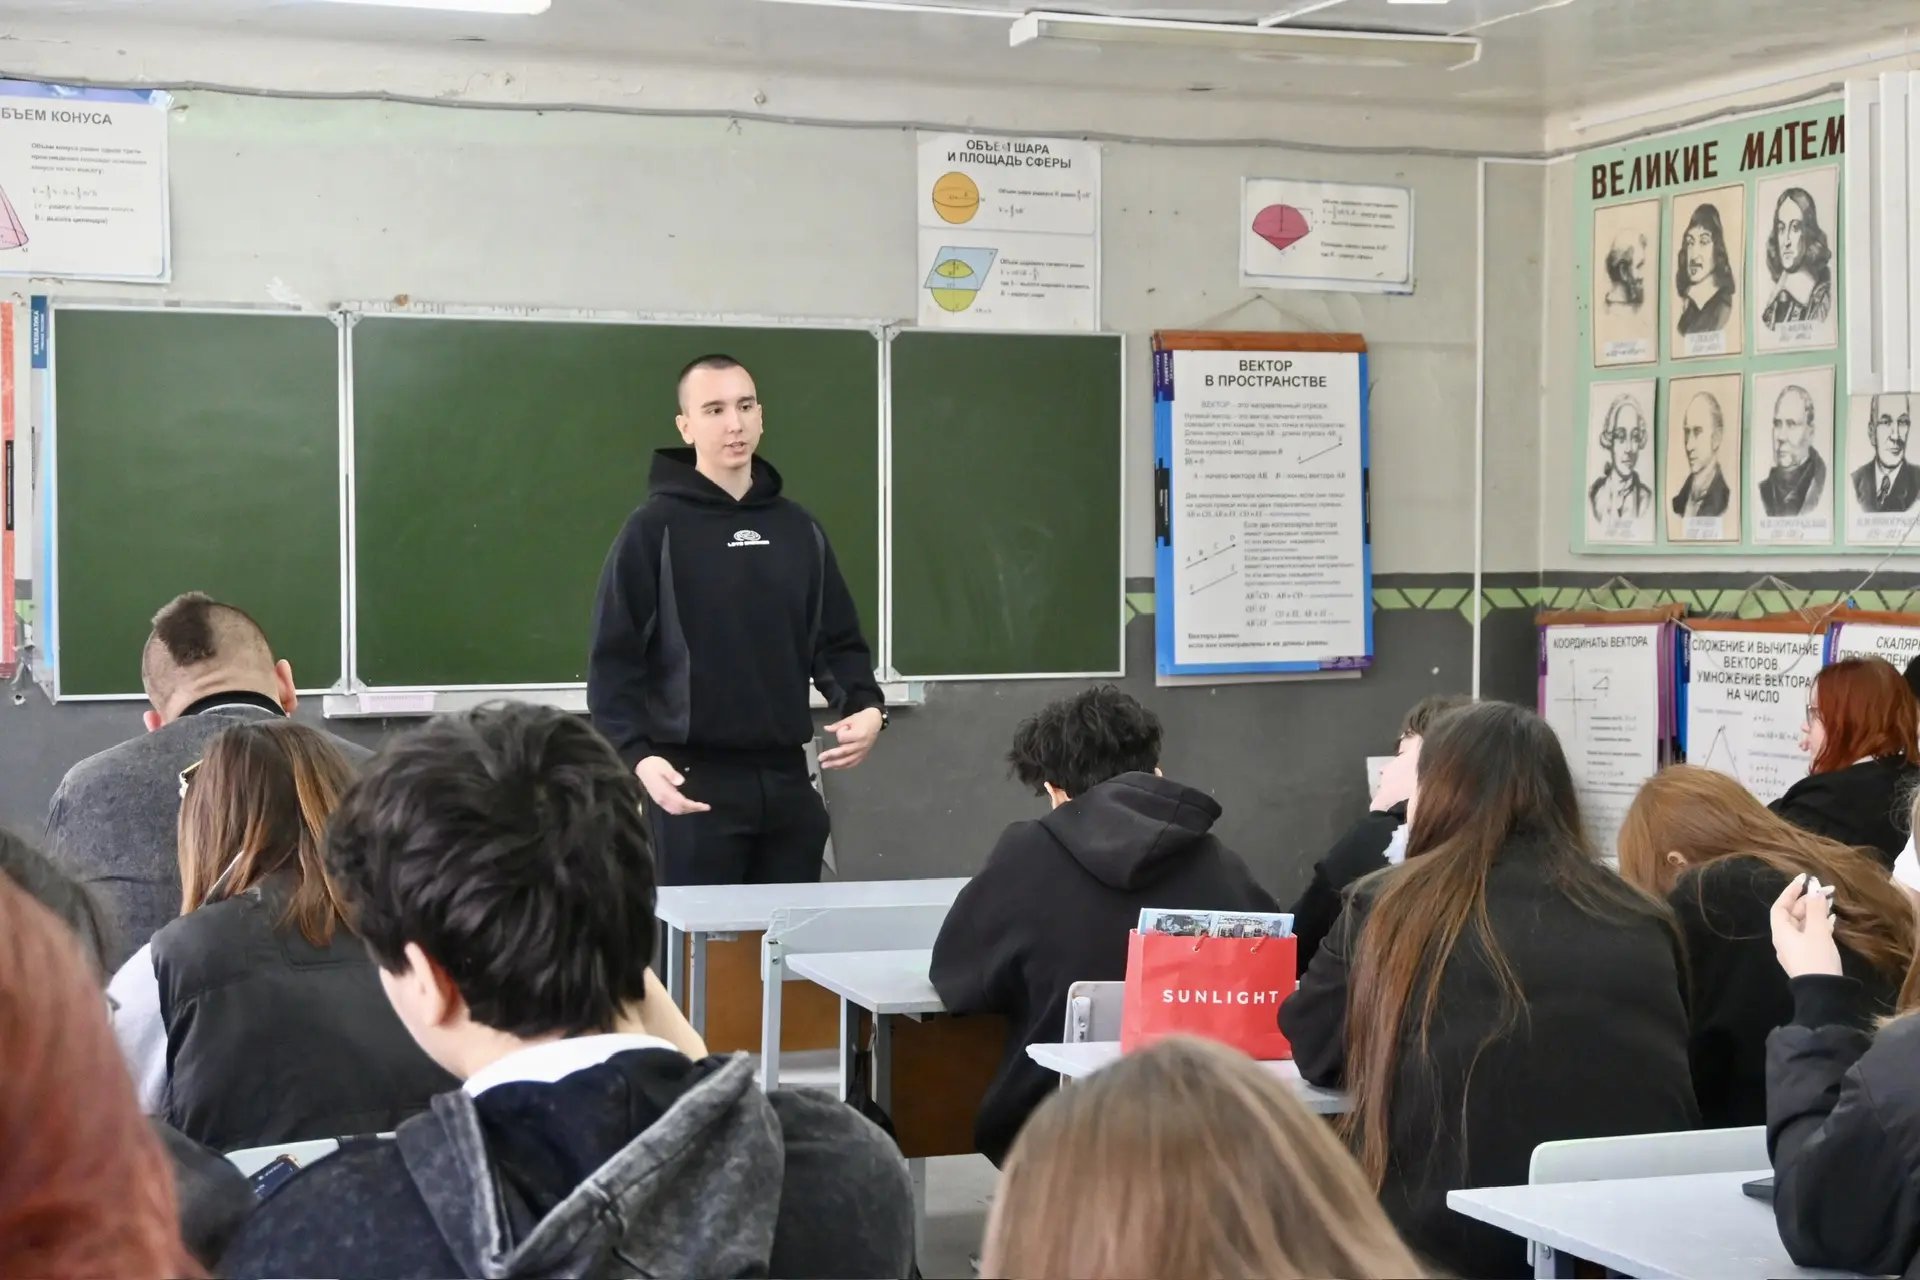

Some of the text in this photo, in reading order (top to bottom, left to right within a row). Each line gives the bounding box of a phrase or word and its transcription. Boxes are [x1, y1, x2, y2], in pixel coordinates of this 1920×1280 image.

[51, 110, 113, 125] КОНУСА
[1014, 143, 1050, 154] ШАРА
[947, 151, 1072, 169] И ПЛОЩАДЬ СФЕРЫ
[1592, 140, 1719, 200] ВЕЛИКИЕ
[1239, 359, 1293, 371] ВЕКТОР
[1205, 375, 1327, 387] В ПРОСТРАНСТВЕ
[1553, 637, 1608, 650] КООРДИНАТЫ
[1610, 636, 1648, 648] ВЕКТОРА
[1692, 639, 1745, 653] СЛОЖЕНИЕ
[1748, 641, 1754, 652] И
[1756, 642, 1819, 656] ВЫЧИТАНИЕ
[1697, 671, 1812, 688] УМНОЖЕНИЕ ВЕКТОРА
[1727, 688, 1780, 703] НА ЧИСЛО
[1163, 989, 1279, 1004] SUNLIGHT
